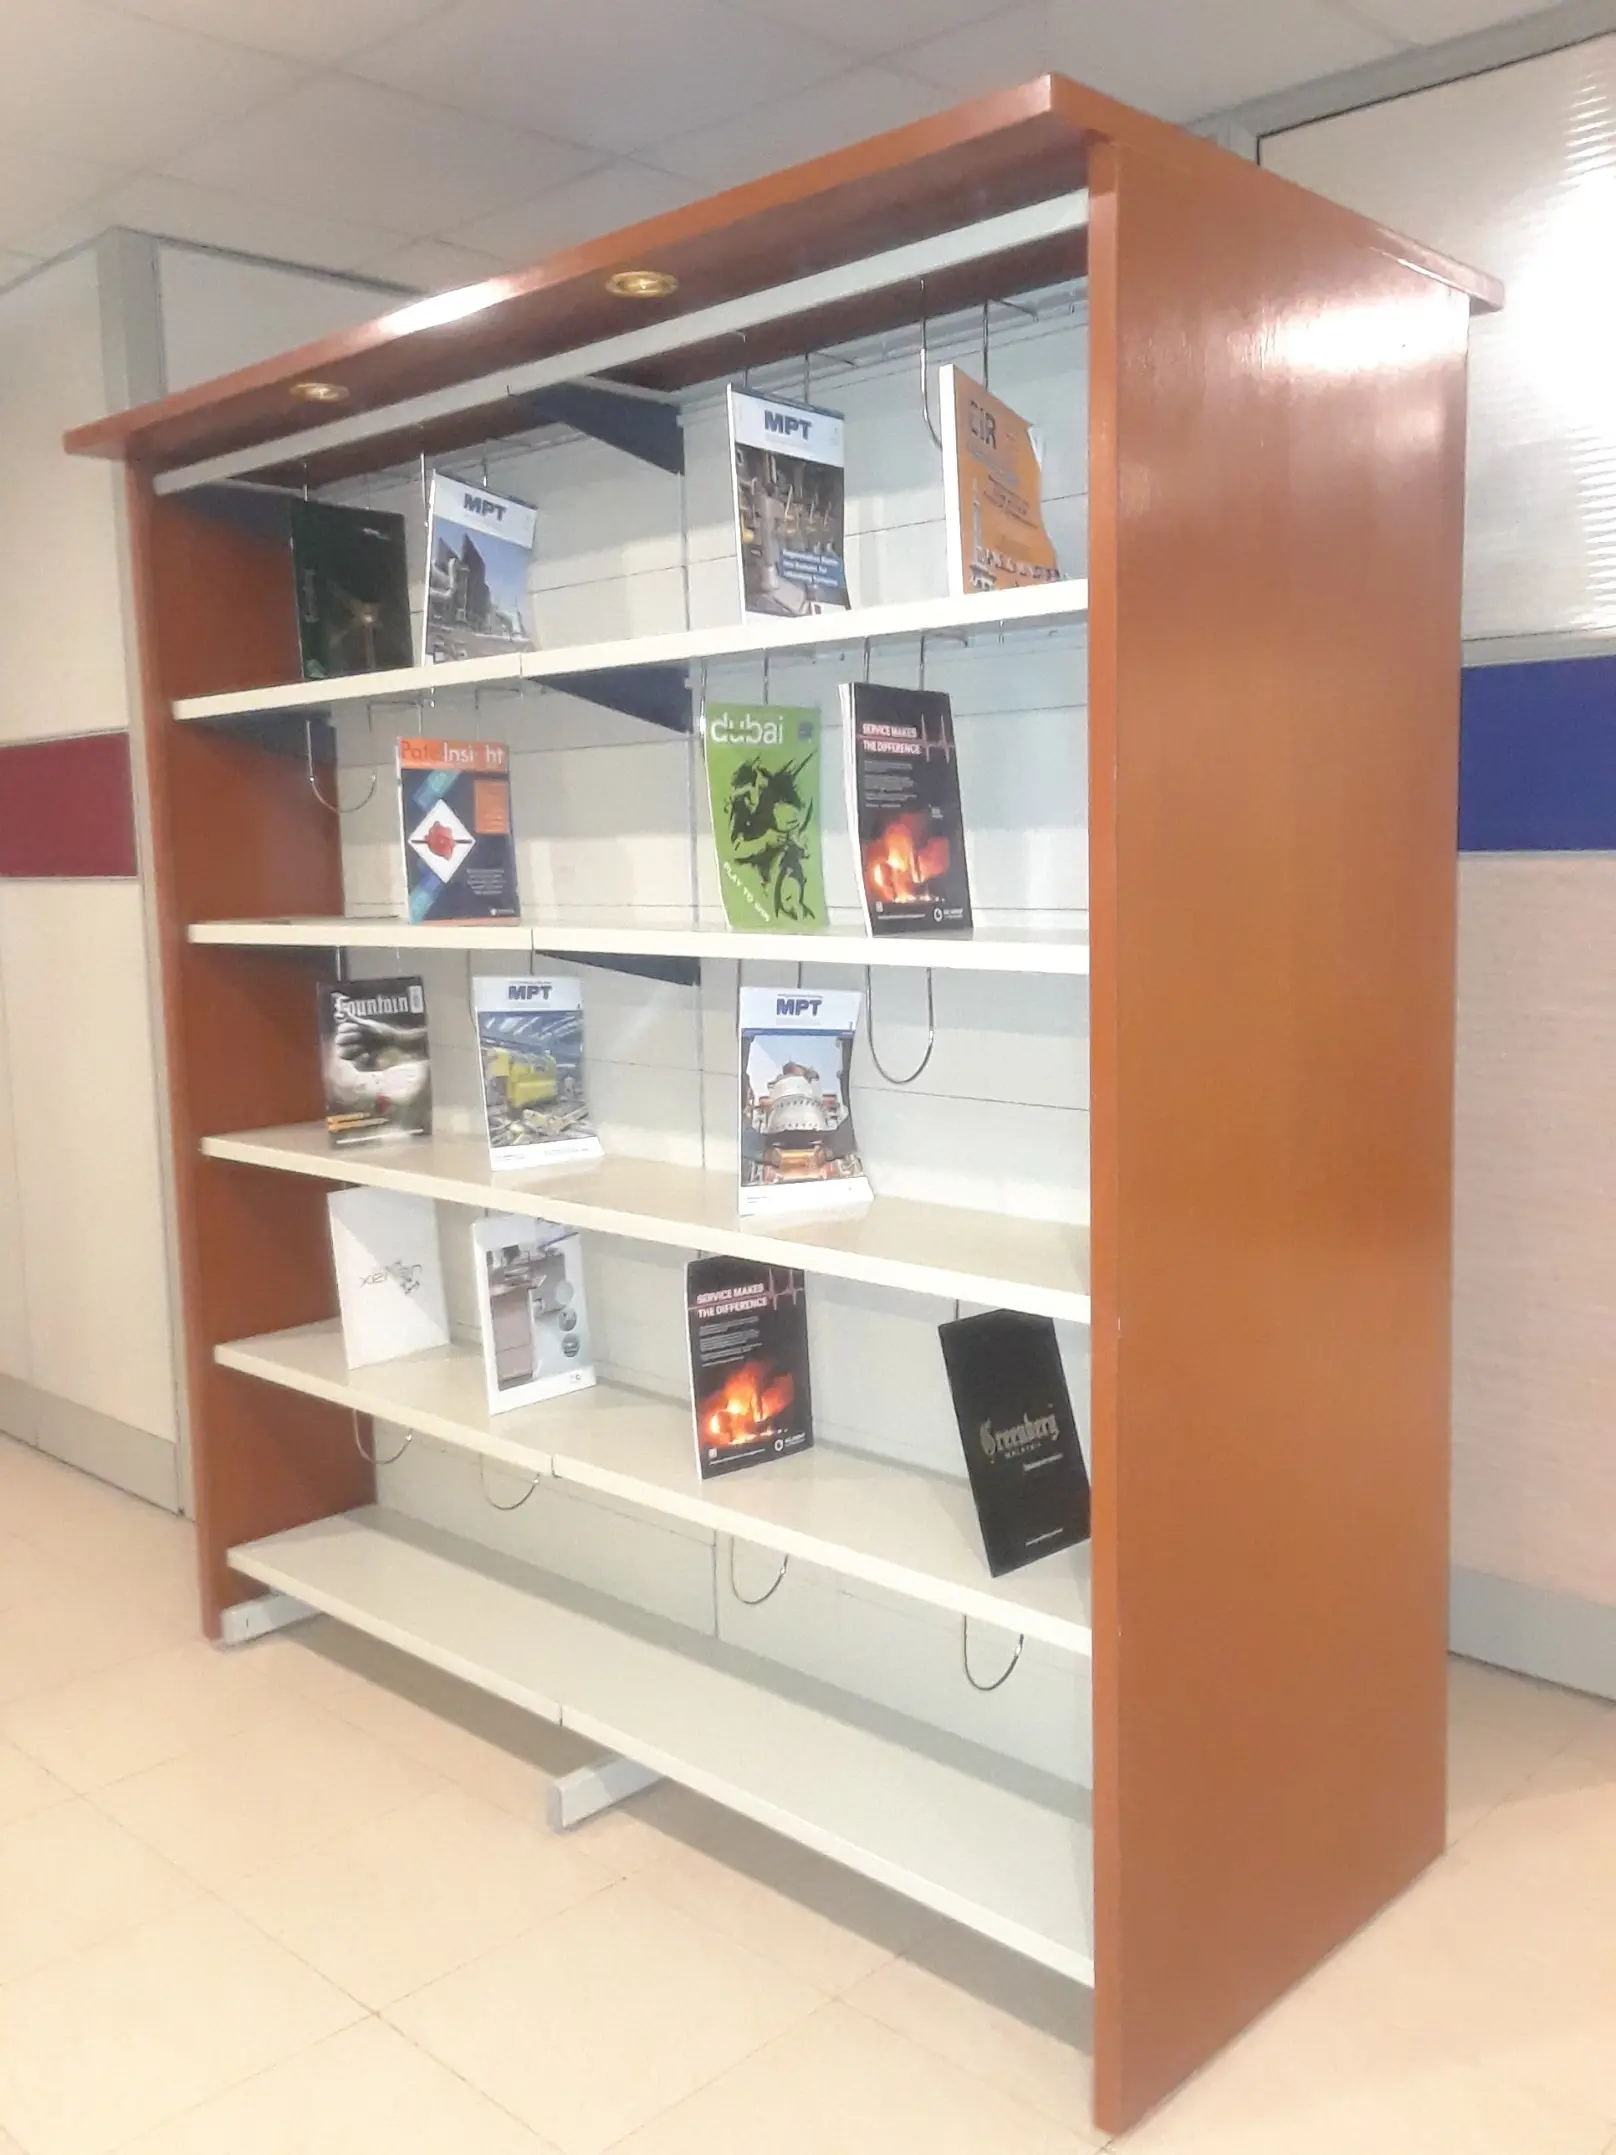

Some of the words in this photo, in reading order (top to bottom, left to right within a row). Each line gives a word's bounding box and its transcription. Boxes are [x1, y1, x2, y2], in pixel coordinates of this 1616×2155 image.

[764, 410, 812, 440] MPT
[463, 493, 507, 521] MPT
[710, 711, 784, 745] dubai
[443, 741, 504, 764] Insiht
[863, 739, 877, 752] THE
[877, 741, 921, 755] DIFFERENCE
[508, 985, 552, 1000] MPT
[776, 998, 822, 1016] MPT
[696, 1289, 733, 1304] SERVICE
[733, 1282, 765, 1295] MAKES
[698, 1306, 715, 1318] THE
[715, 1296, 768, 1316] DIFFERENCE
